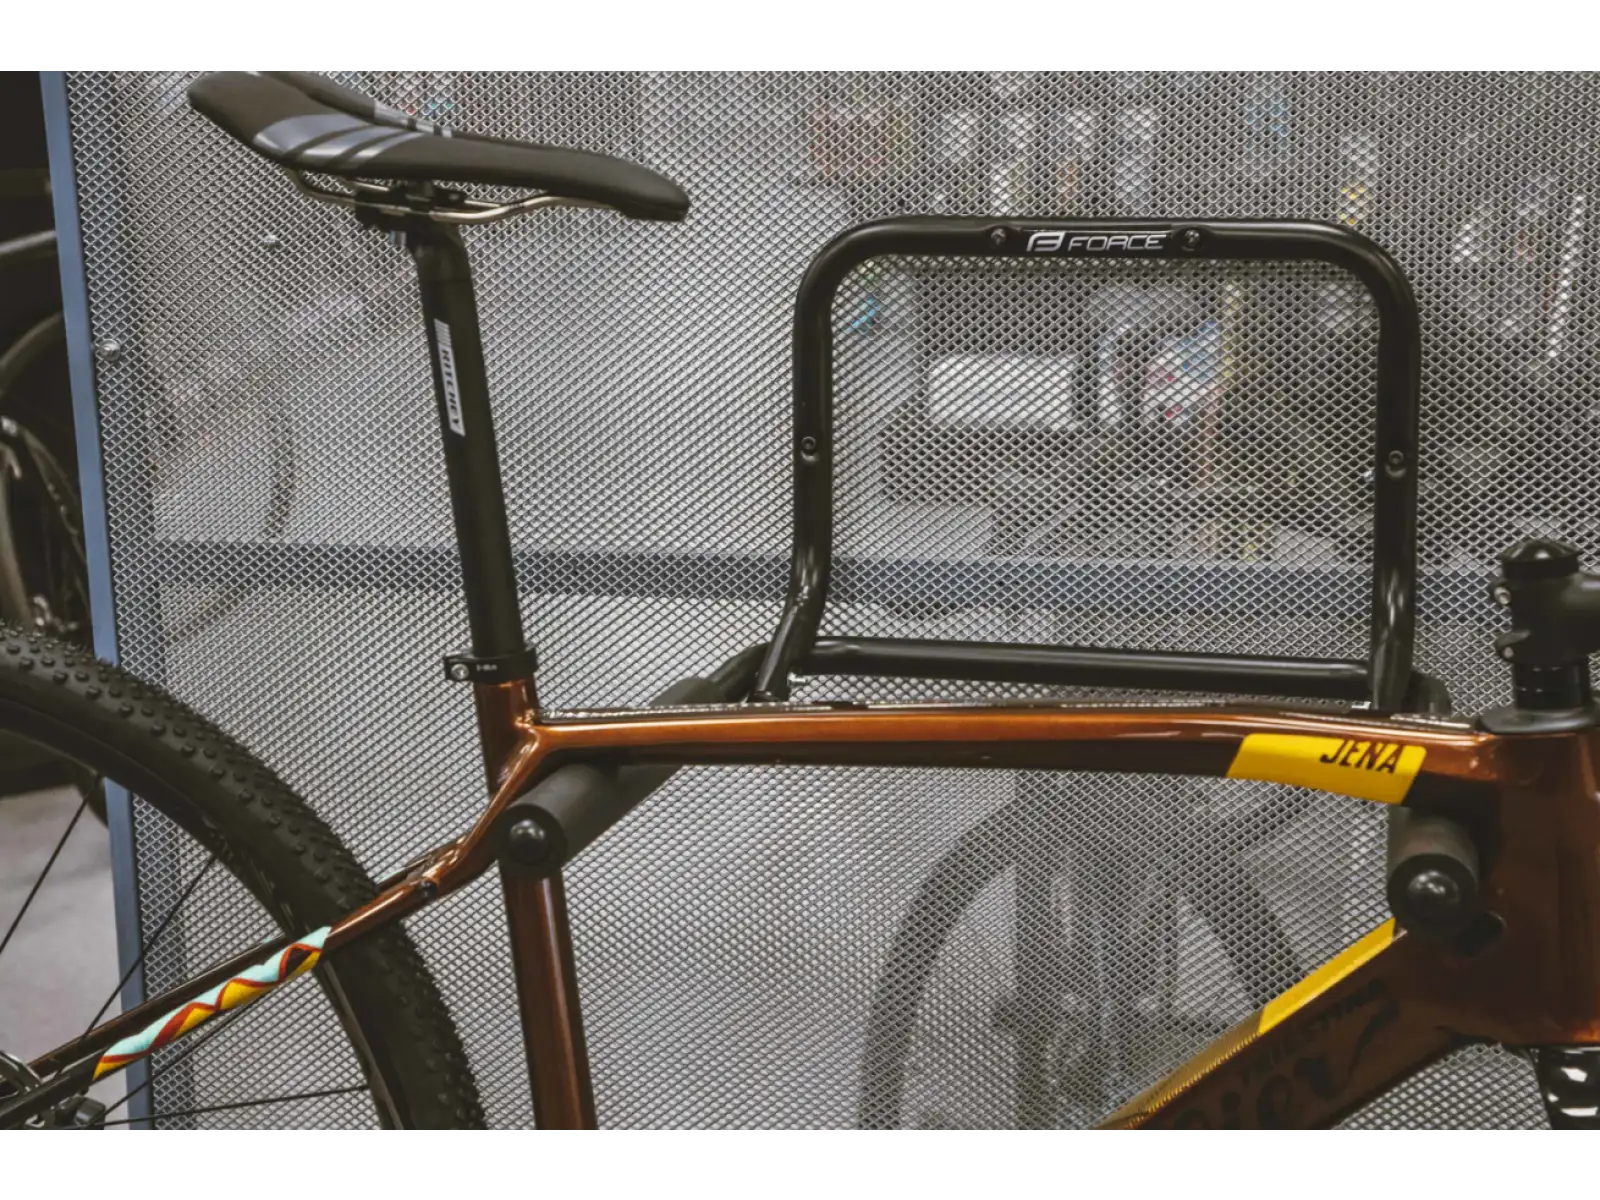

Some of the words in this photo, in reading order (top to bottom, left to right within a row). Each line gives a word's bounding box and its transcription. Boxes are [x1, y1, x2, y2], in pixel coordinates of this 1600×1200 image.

[1068, 234, 1167, 251] FORCE
[441, 349, 460, 425] RITCHEY
[1319, 739, 1404, 774] JENA
